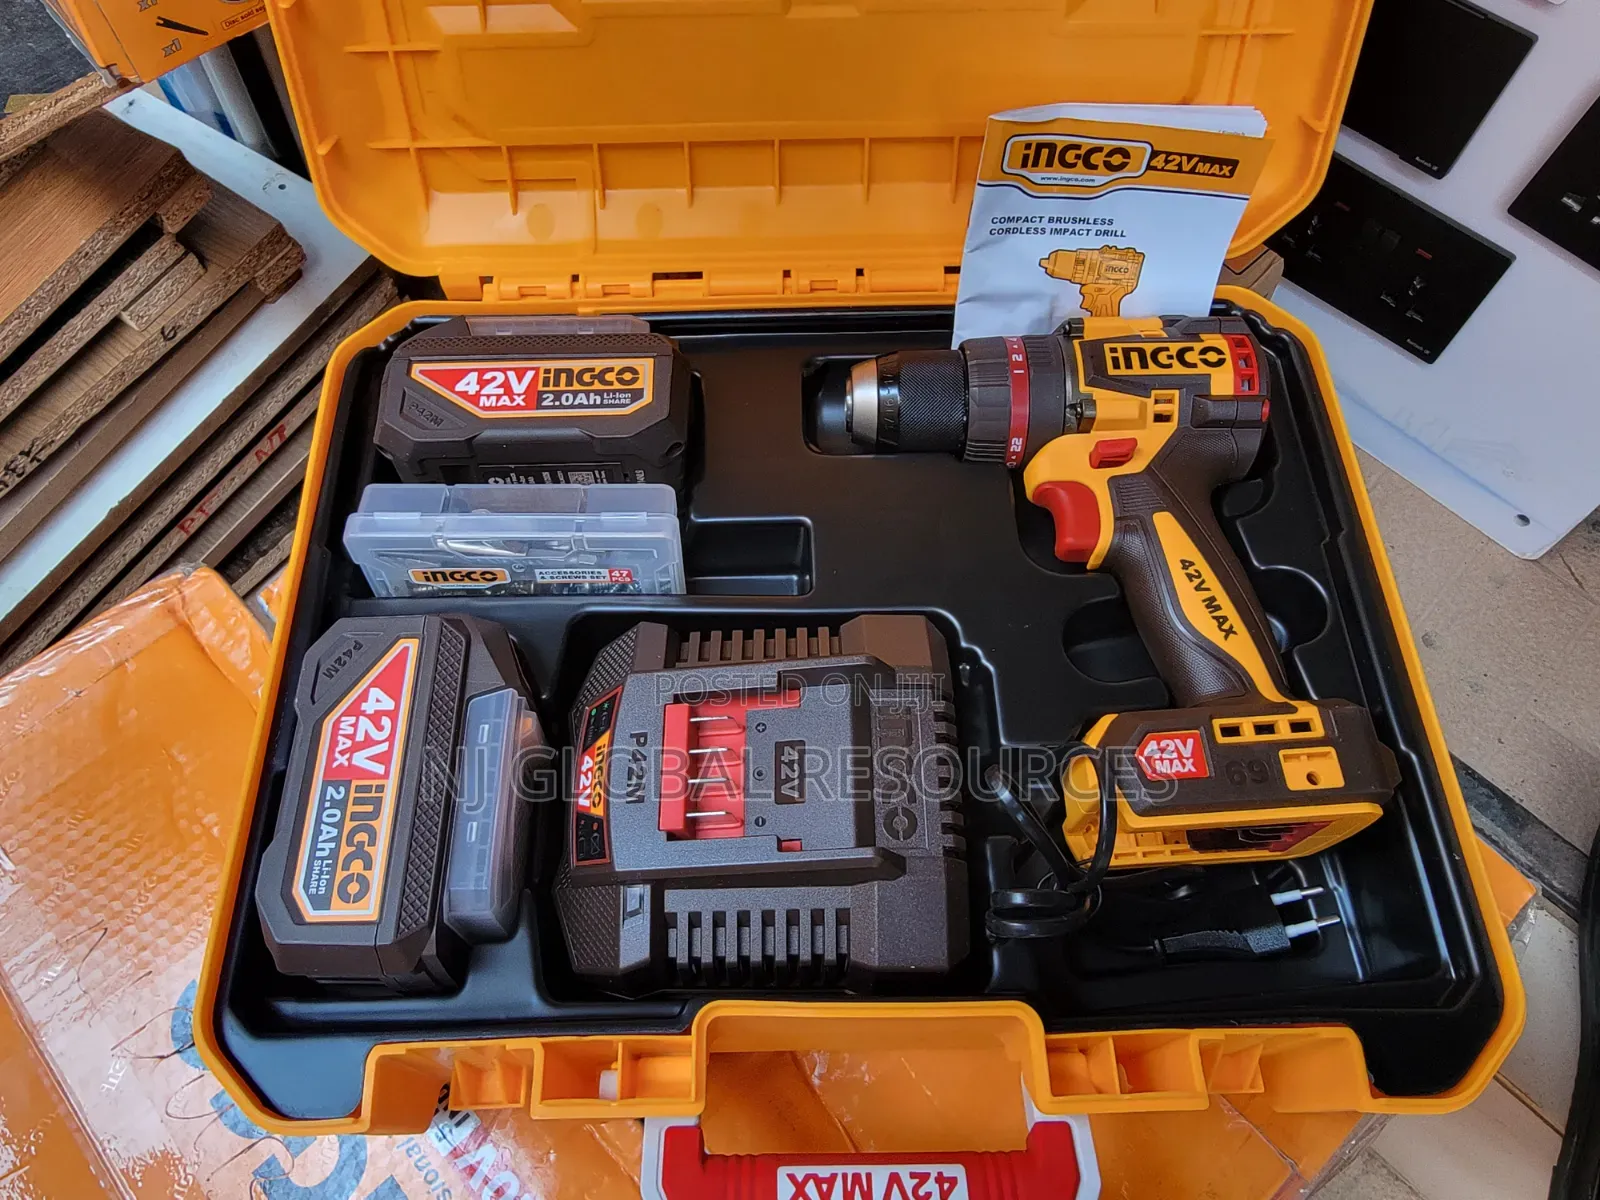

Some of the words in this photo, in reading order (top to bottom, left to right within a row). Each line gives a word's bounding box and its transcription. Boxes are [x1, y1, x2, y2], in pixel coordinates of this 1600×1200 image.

[1040, 174, 1096, 184] www.ingco.com
[989, 226, 1047, 237] CORDLESS
[1049, 227, 1093, 238] IMPACT
[1094, 228, 1127, 239] DRILL
[990, 216, 1045, 226] COMPACT
[1047, 216, 1114, 227] BRUSHLESS
[455, 370, 536, 396] 42V
[603, 392, 632, 400] Li-Ion
[478, 395, 527, 407] MAX
[541, 392, 601, 407] 2.0Ah
[611, 569, 628, 577] 47
[1201, 594, 1239, 641] MAX
[322, 639, 364, 681] P42M
[333, 716, 356, 768] MAX
[351, 687, 396, 775] 42V
[1143, 738, 1195, 759] 42V
[626, 731, 648, 804] P42M
[780, 745, 800, 799] 42V
[1155, 758, 1197, 774] MAX
[578, 755, 594, 807] 42V
[316, 785, 346, 858] 2.0Ah
[308, 859, 322, 895] SHARE
[317, 859, 334, 896] Li-Ion
[785, 1171, 874, 1200] MAX
[882, 1171, 959, 1200] 42V
